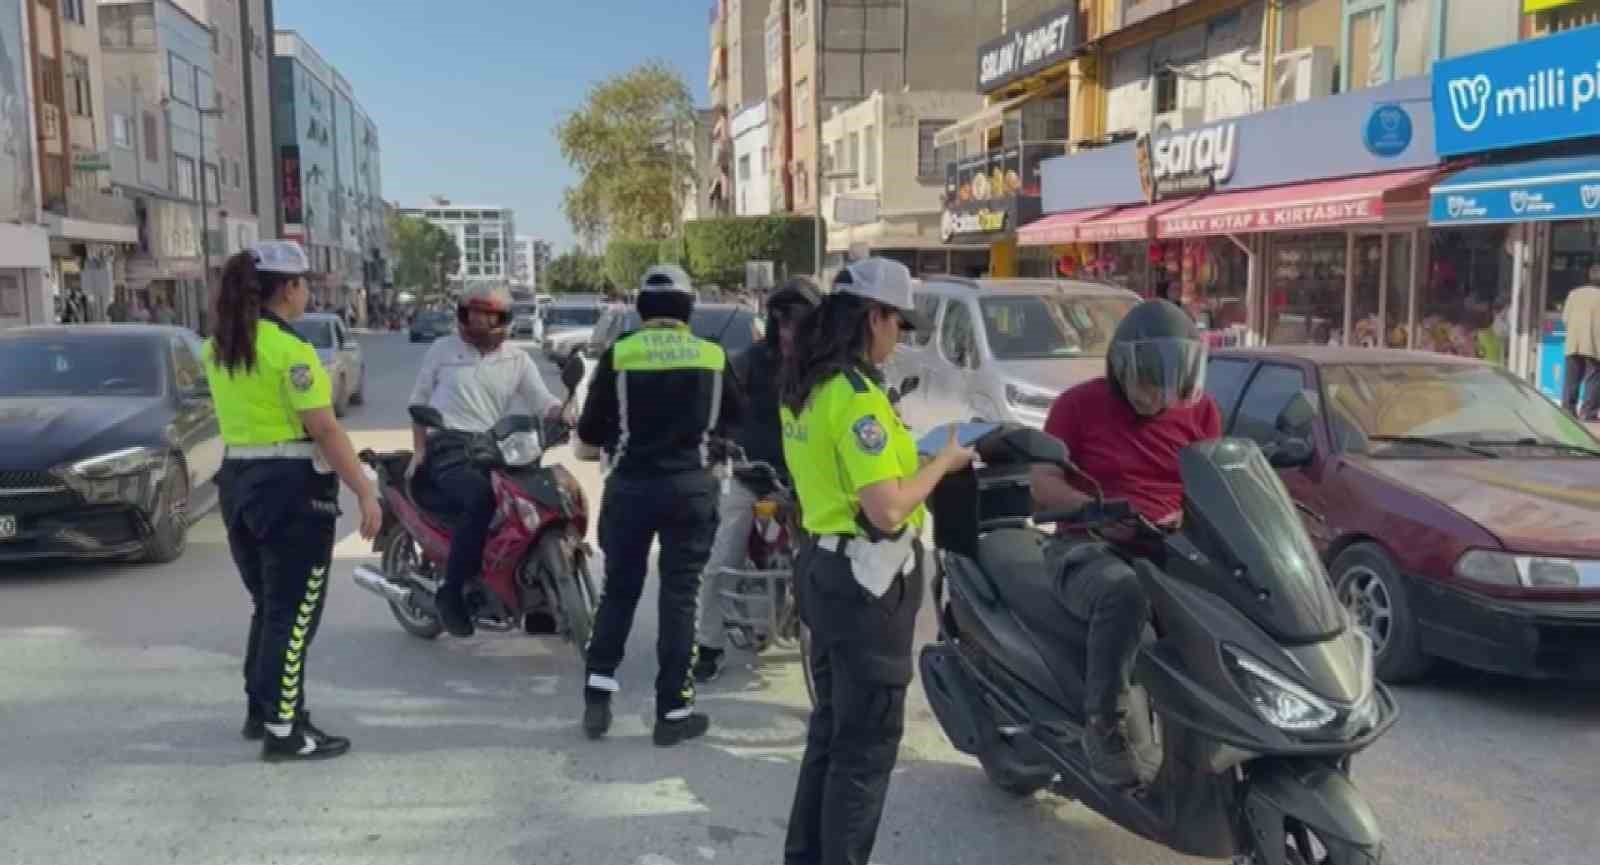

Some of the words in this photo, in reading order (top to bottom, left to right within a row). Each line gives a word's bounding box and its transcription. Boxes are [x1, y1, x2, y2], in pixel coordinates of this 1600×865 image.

[1496, 67, 1566, 117] milli
[1153, 122, 1236, 184] saray
[1164, 217, 1207, 234] SARAY
